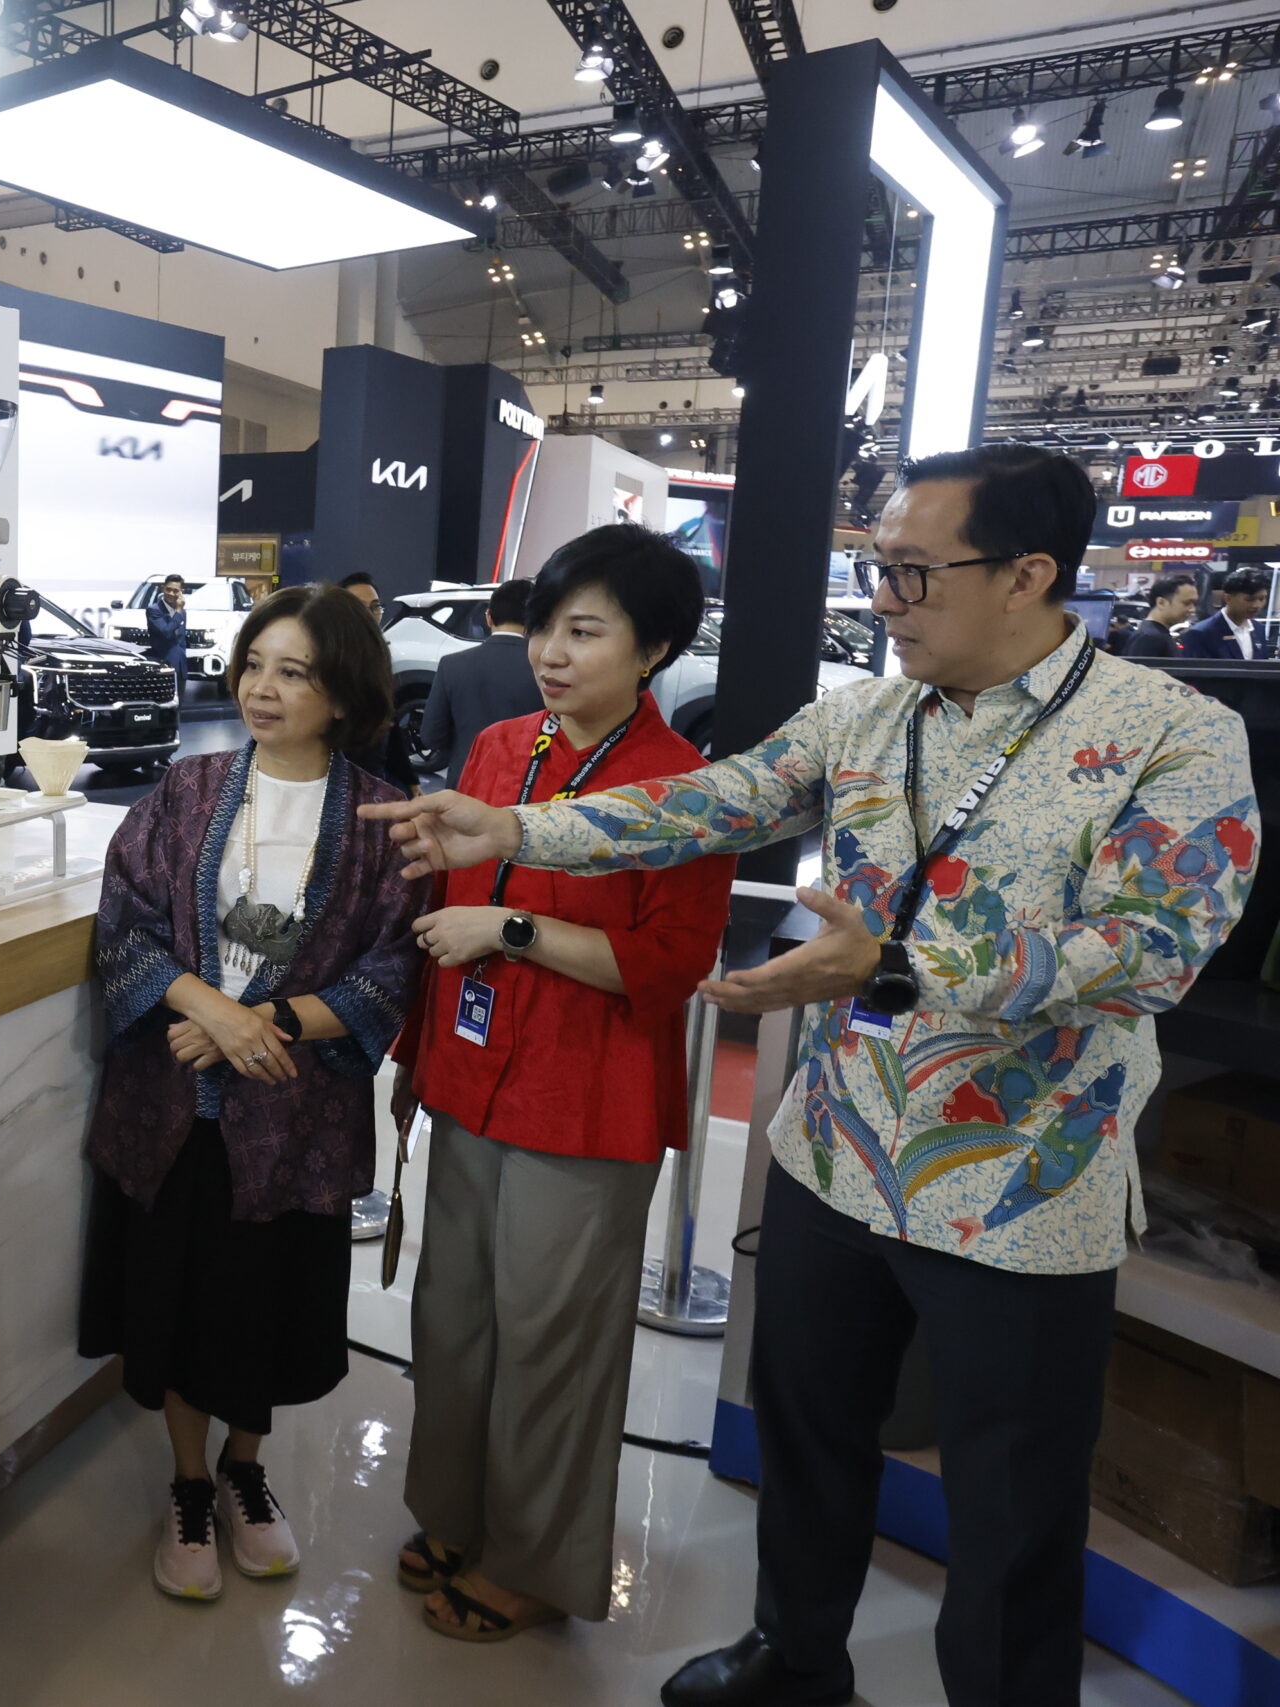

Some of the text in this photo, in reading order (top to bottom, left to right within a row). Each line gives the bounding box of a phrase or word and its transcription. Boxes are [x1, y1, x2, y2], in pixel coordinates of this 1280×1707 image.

[371, 457, 428, 491] KIA
[1135, 465, 1166, 487] MG
[1150, 547, 1210, 557] HINO
[1078, 646, 1093, 670] AUTO
[1061, 670, 1081, 698] SHOW
[570, 726, 627, 787] AUTO SHOW SERIES
[525, 760, 539, 786] SERIES
